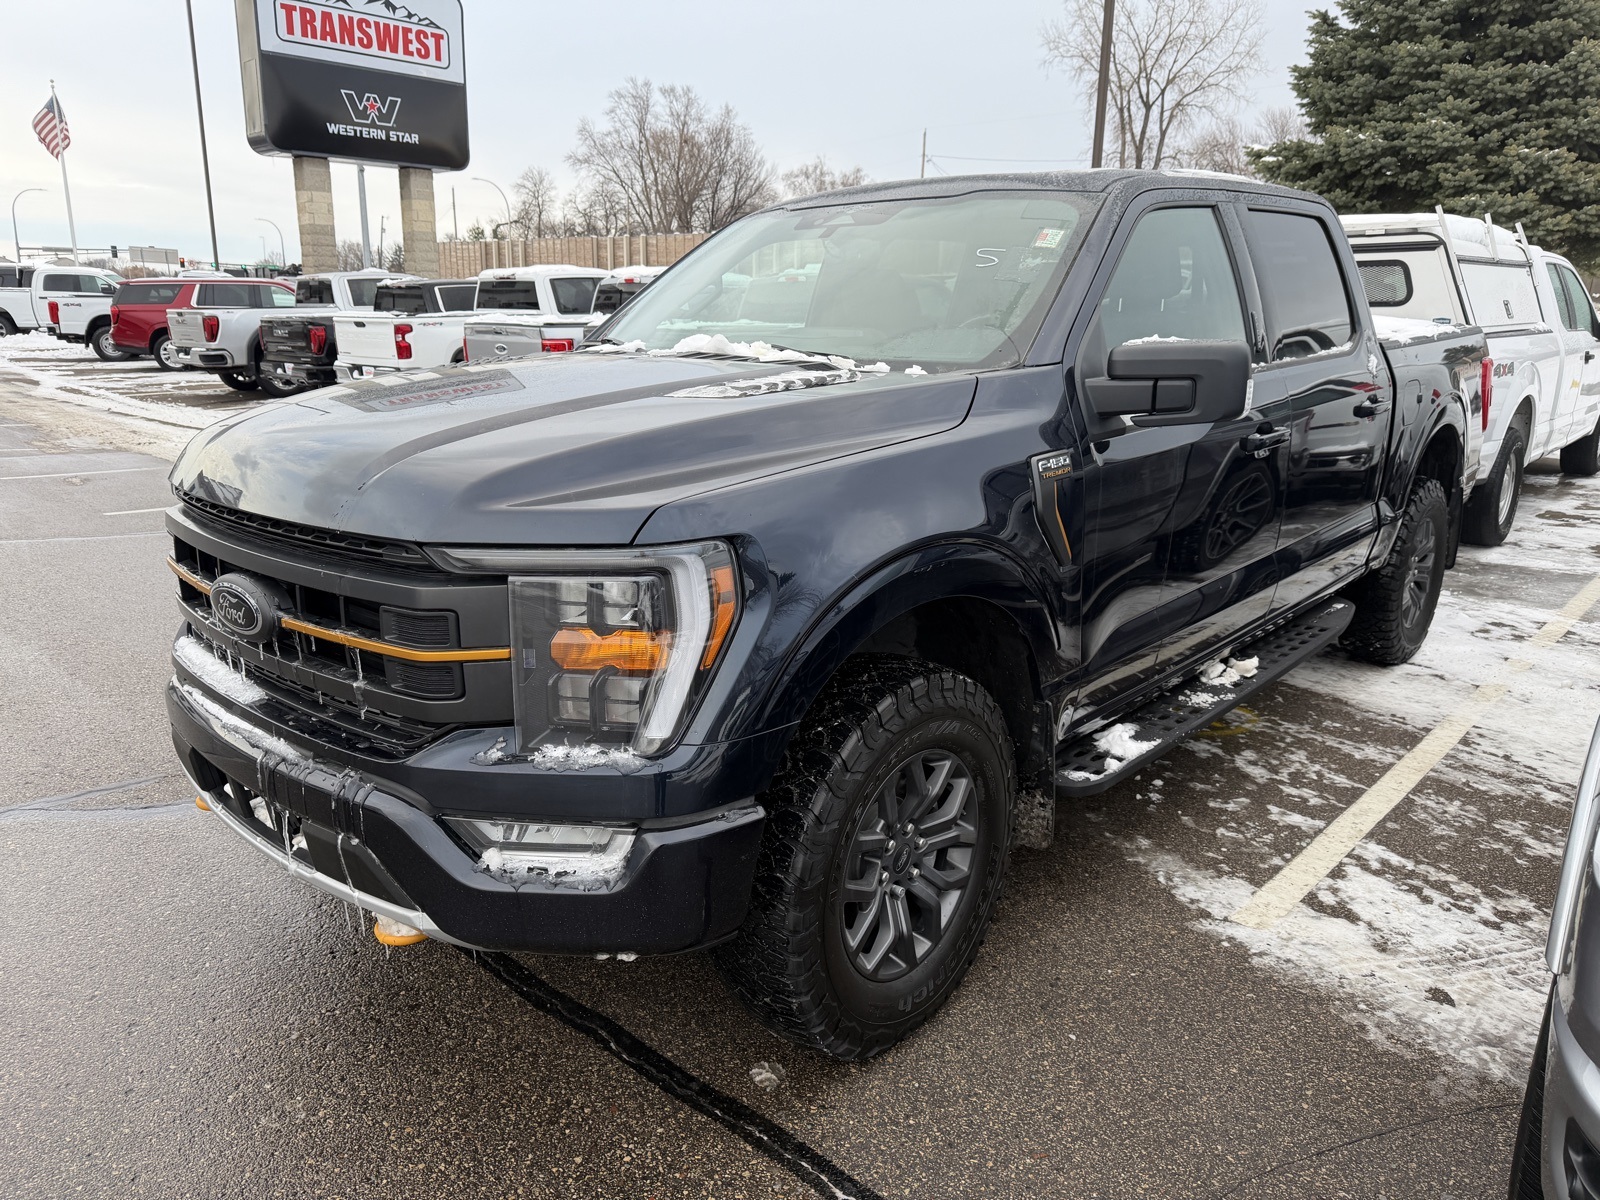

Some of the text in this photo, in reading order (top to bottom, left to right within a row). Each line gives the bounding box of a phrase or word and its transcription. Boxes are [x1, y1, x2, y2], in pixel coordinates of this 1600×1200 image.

[280, 3, 445, 62] TRANSWEST
[326, 122, 419, 145] WESTERN STAR
[1041, 467, 1072, 479] TREMOR
[217, 592, 246, 625] Ford
